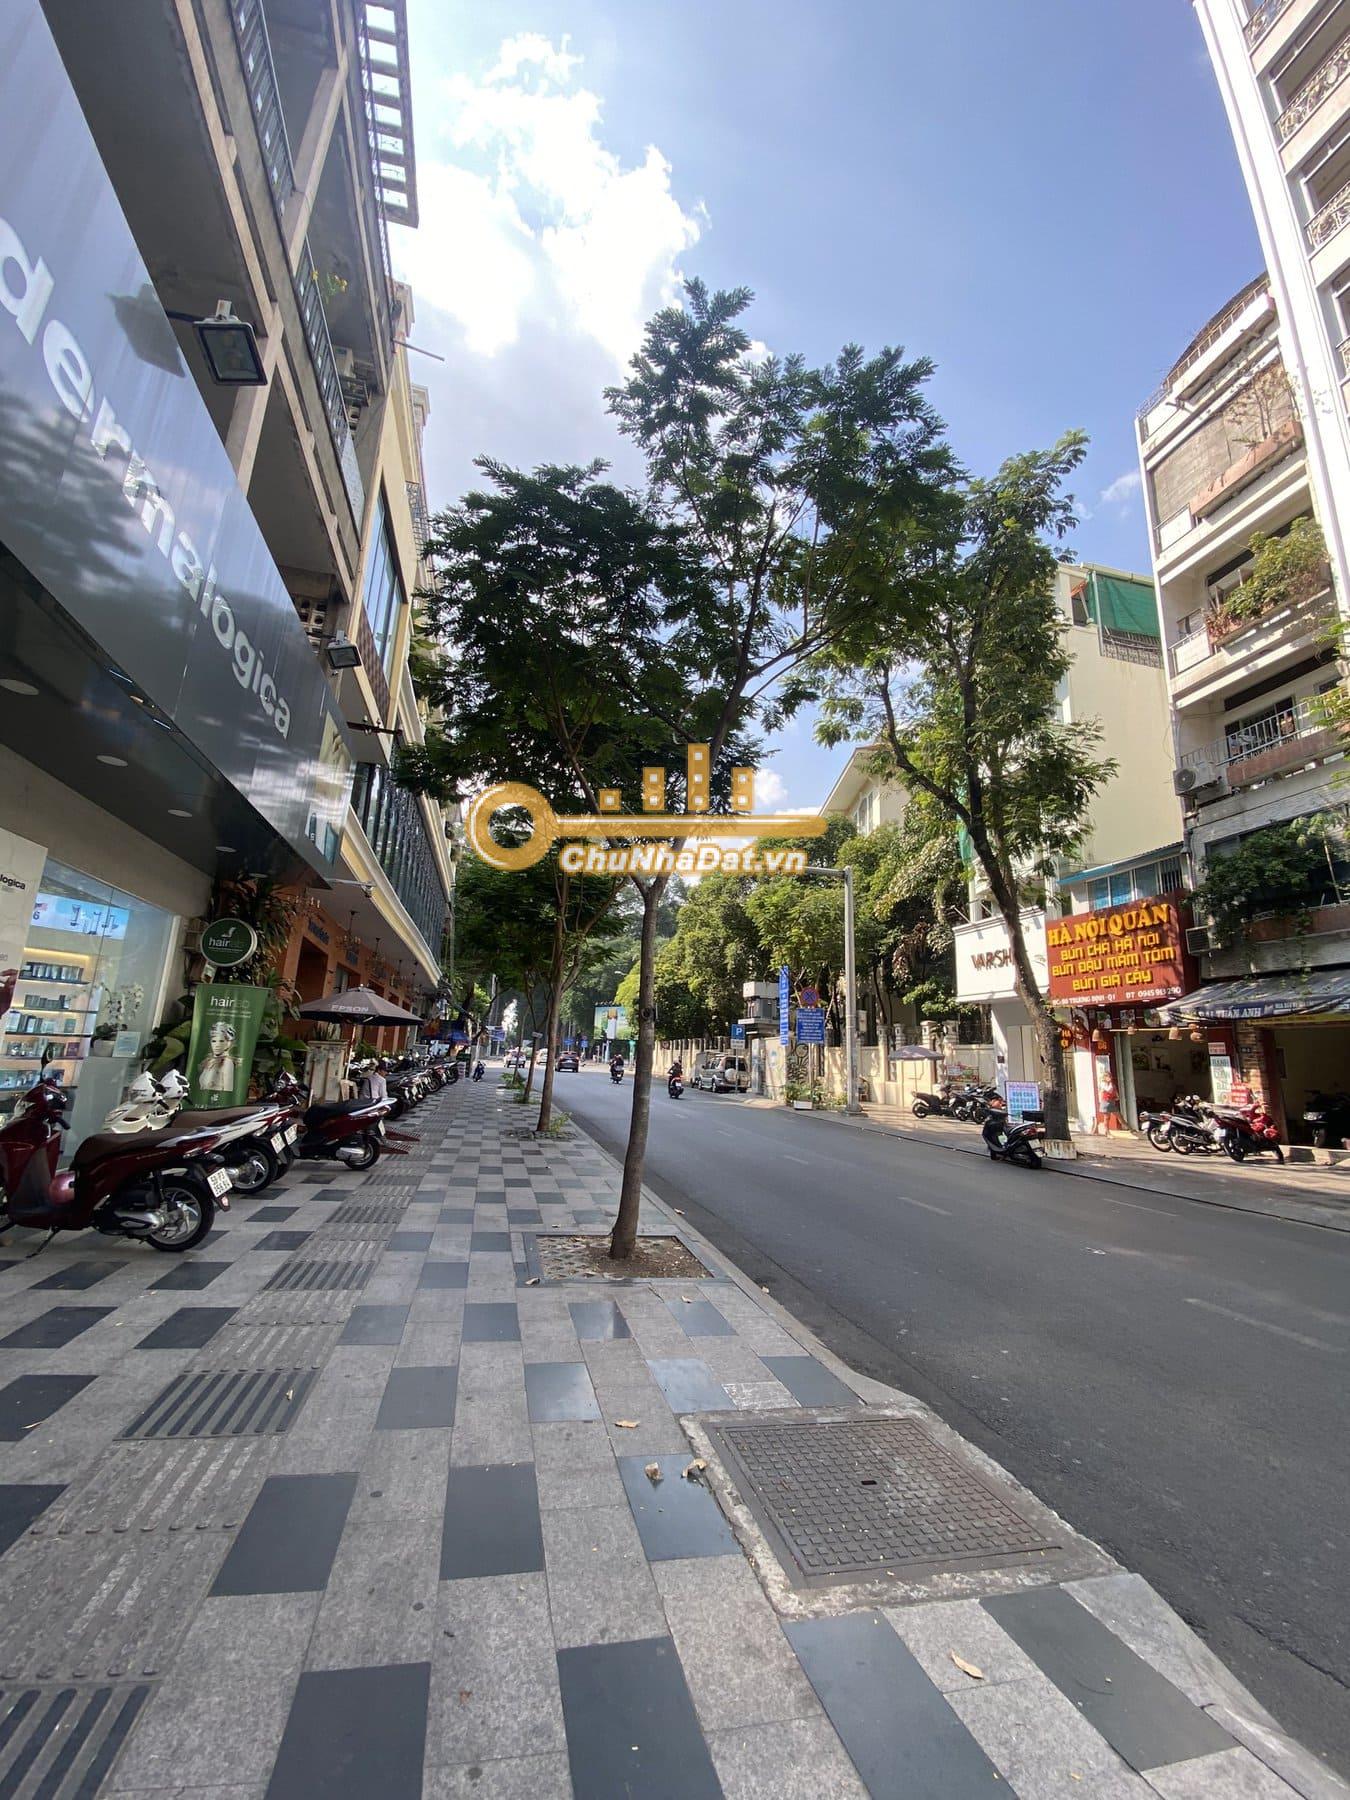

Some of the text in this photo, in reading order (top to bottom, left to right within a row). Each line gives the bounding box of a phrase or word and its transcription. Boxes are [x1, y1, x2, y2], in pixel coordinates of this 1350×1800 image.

[0, 217, 290, 739] dermalogica
[1047, 902, 1170, 945] HÀ NỘI QUÁN
[1061, 945, 1083, 961] BÚN
[1052, 961, 1075, 976] BÚN
[1072, 975, 1096, 991] BÚN
[331, 1004, 369, 1013] EPSON
[735, 1027, 743, 1036] P
